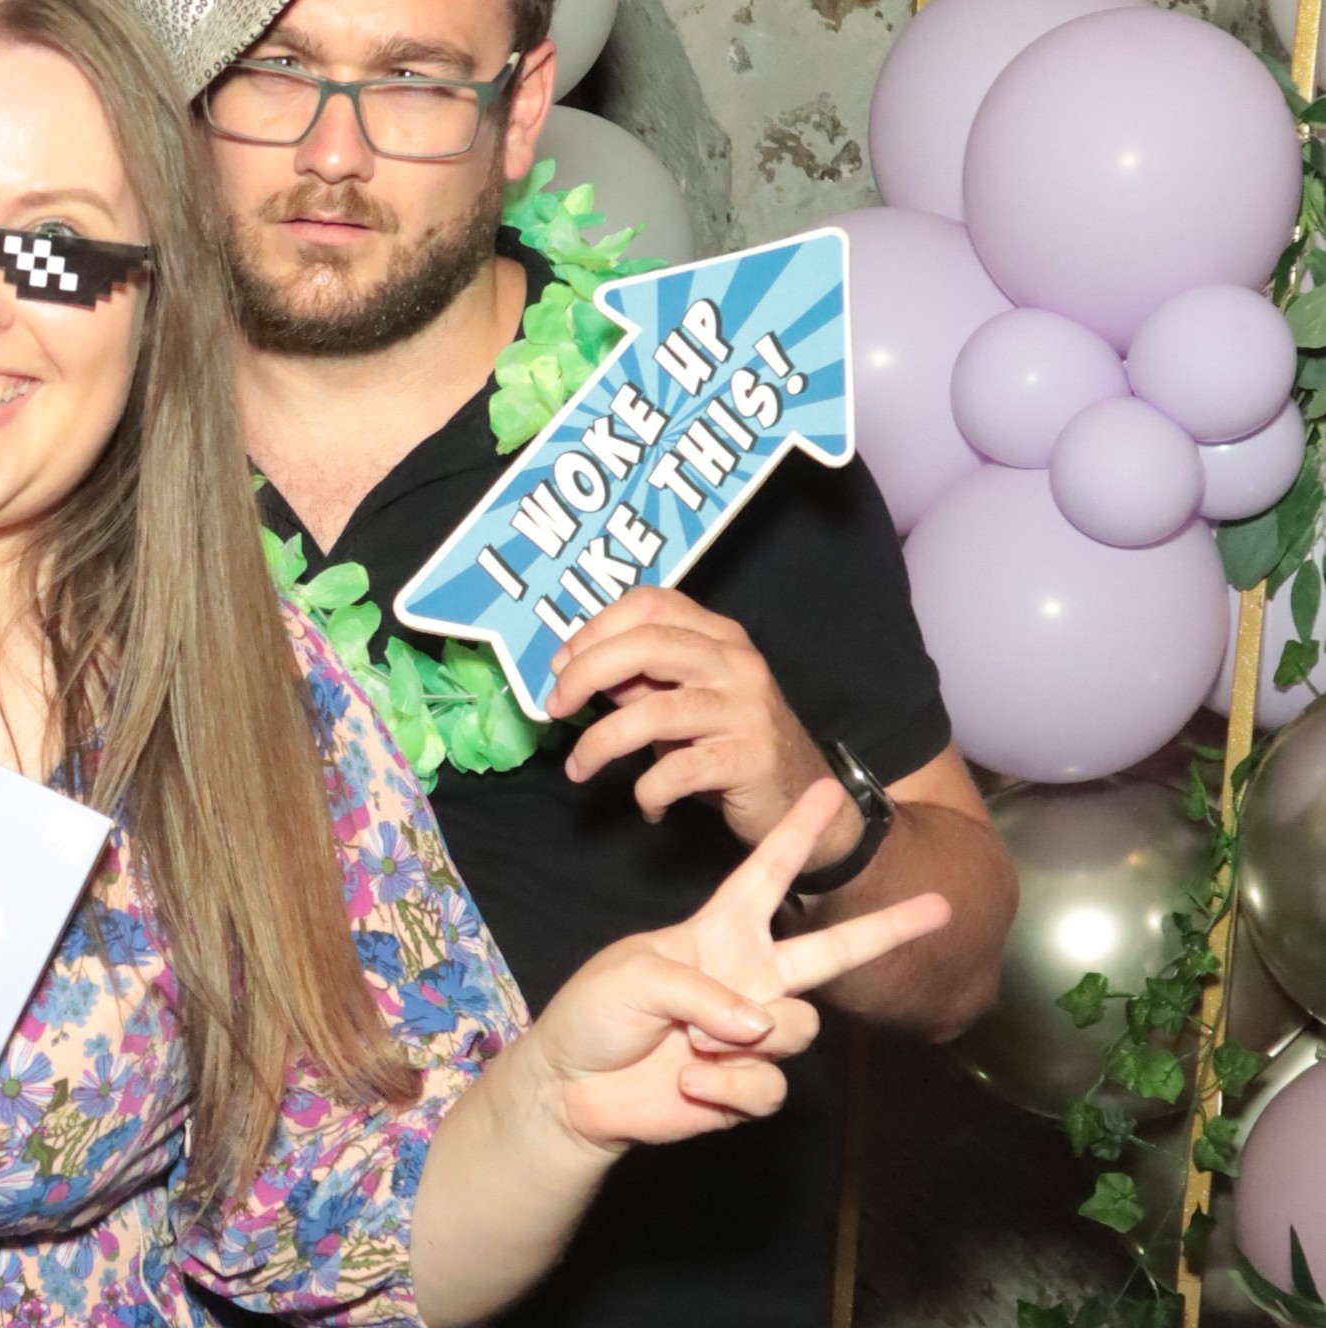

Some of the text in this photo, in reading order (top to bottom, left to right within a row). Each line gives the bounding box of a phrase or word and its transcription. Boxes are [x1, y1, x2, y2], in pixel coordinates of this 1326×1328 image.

[477, 298, 734, 602] I WOKE UP
[534, 332, 809, 643] LIKE THIS!
